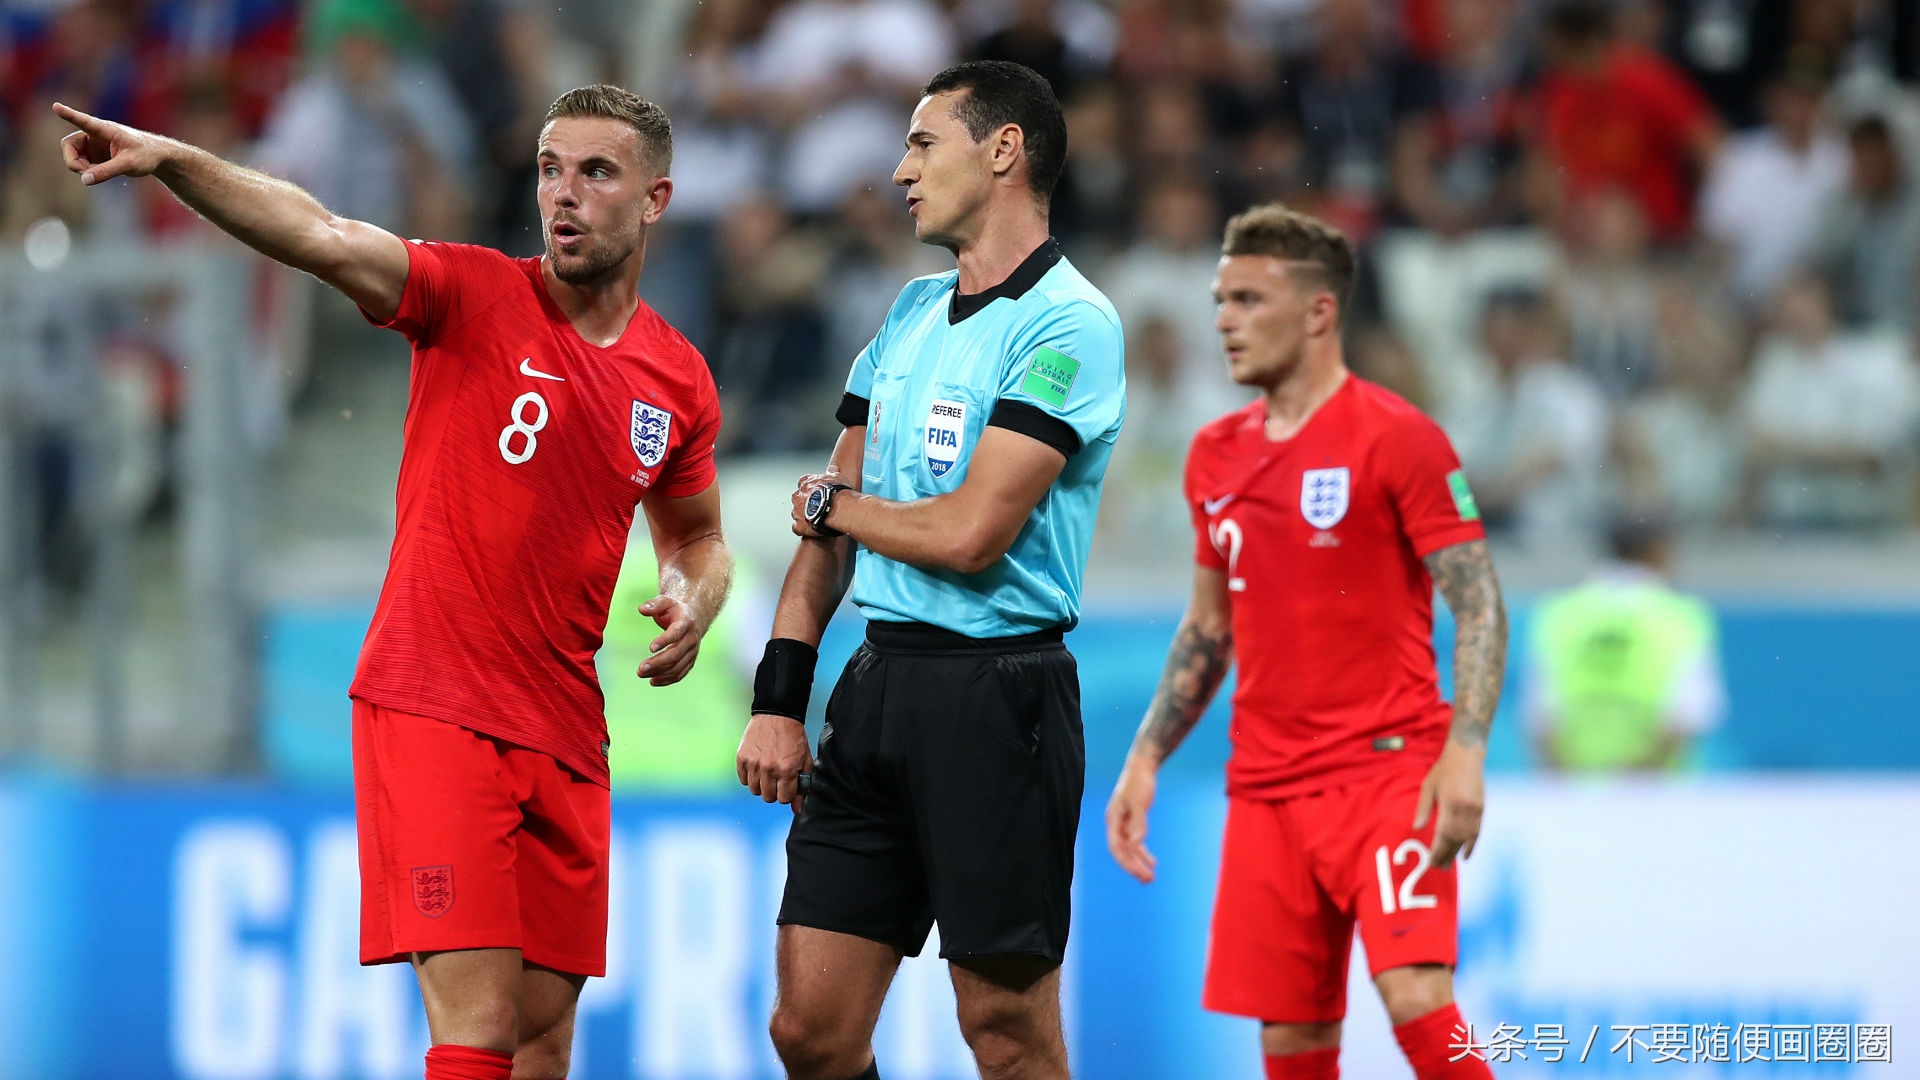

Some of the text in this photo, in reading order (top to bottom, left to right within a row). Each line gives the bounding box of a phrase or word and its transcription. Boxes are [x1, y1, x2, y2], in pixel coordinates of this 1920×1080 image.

[1034, 359, 1073, 380] LIVING
[1050, 384, 1067, 396] FIFA
[931, 404, 963, 419] REFEREE
[498, 391, 549, 465] 8
[928, 427, 957, 448] FIFA
[931, 461, 947, 473] 2018
[1375, 838, 1438, 915] 12
